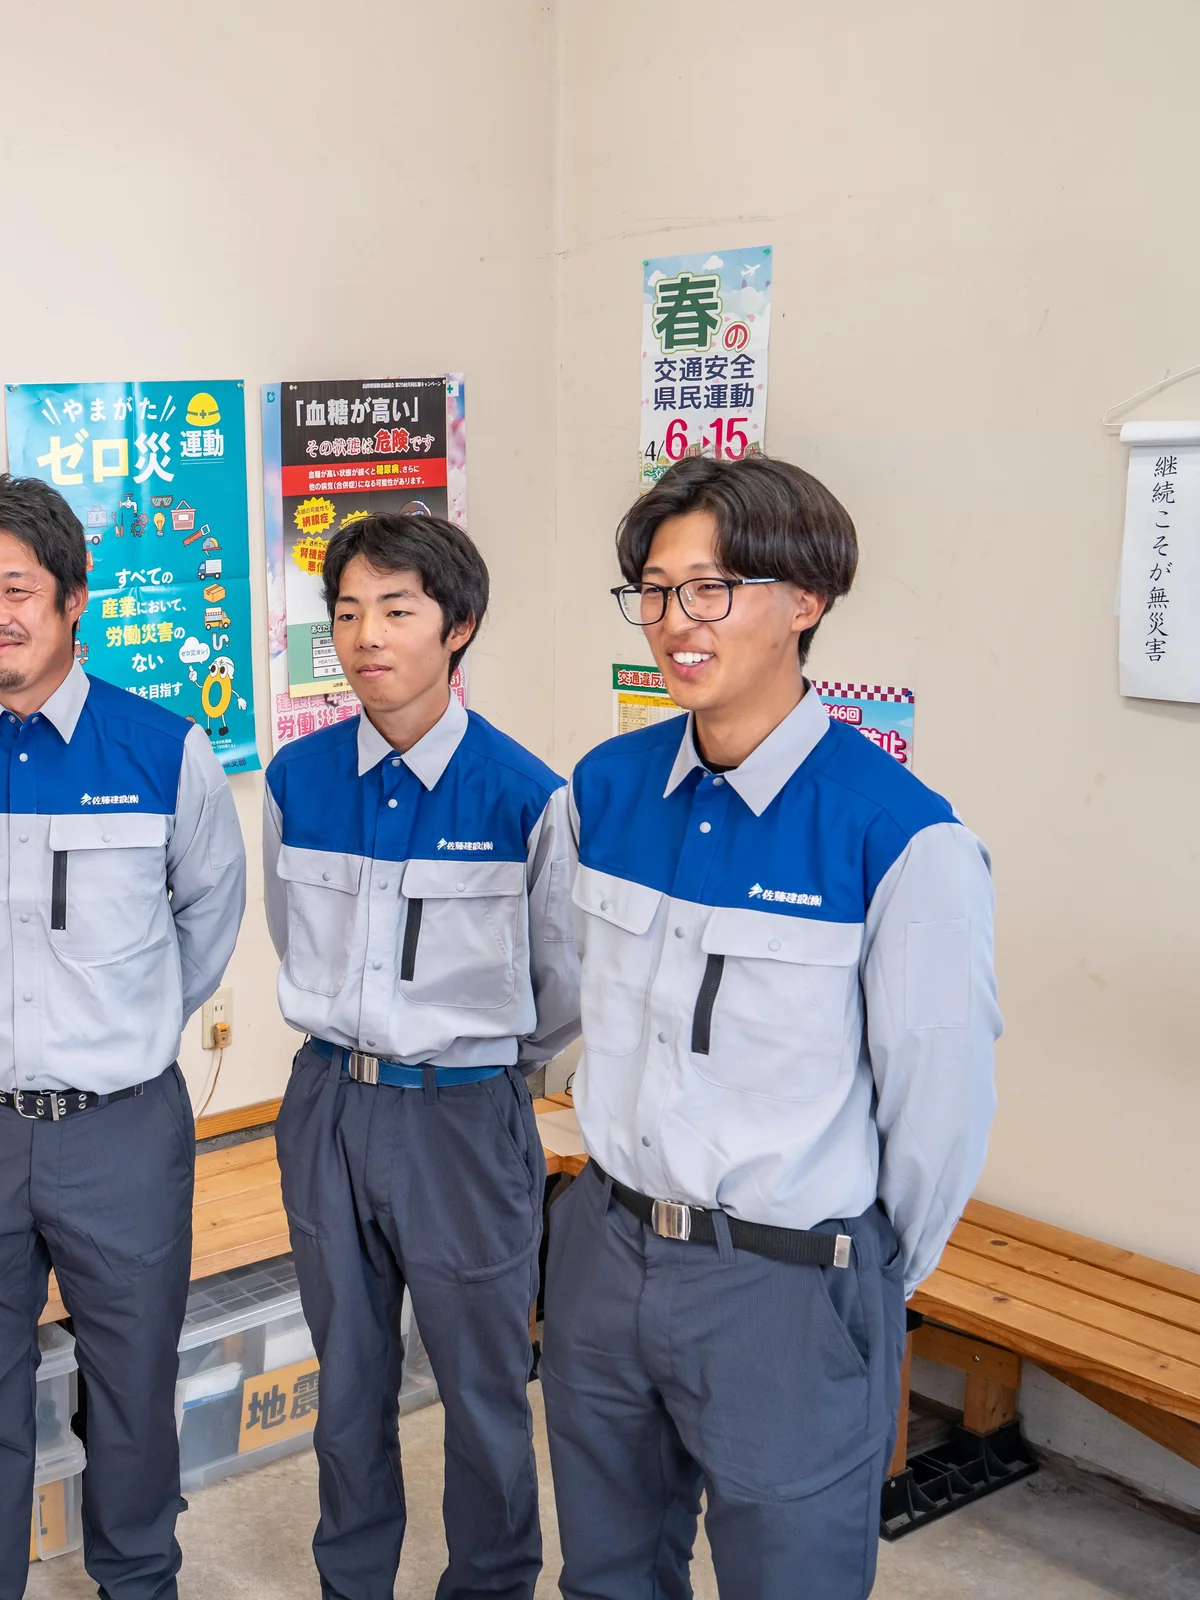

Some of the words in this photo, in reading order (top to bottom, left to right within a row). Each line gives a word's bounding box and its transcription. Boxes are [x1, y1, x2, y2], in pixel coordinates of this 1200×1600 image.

[654, 274, 749, 352] 春の
[654, 353, 755, 383] 交通安全
[62, 396, 158, 422] やまがた
[653, 383, 754, 411] 県民運動
[296, 397, 418, 427] 「血糖が高い」
[37, 428, 175, 485] ゼロ災
[180, 429, 224, 457] 運動
[306, 428, 435, 457] その状態は危険です
[1145, 455, 1178, 662] 継続こそが無災害
[115, 567, 173, 589] すべての
[102, 596, 187, 619] 産業において、
[106, 622, 185, 647] 労働災害の
[132, 653, 164, 672] ない
